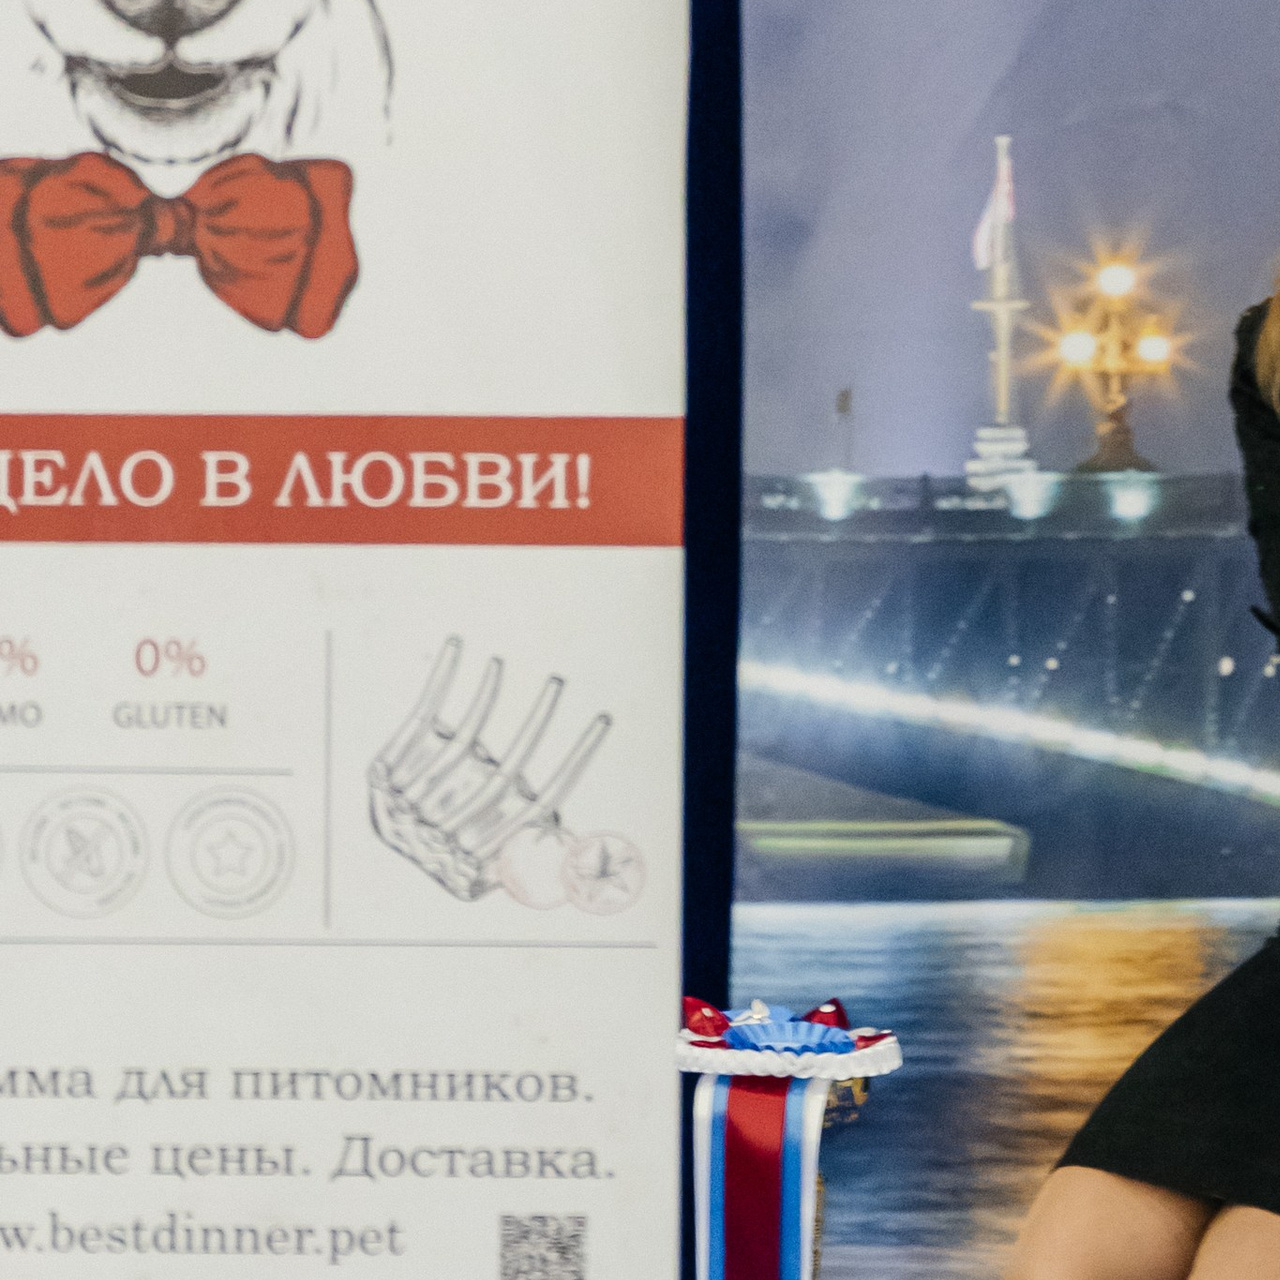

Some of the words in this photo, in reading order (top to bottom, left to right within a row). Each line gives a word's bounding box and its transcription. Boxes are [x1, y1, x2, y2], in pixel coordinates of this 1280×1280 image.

[201, 451, 252, 506] В
[276, 451, 590, 508] ЛЮБВИ!
[135, 638, 205, 677] 0%
[113, 702, 227, 729] GLUTEN
[115, 1069, 207, 1102] для
[233, 1070, 593, 1102] питомников.
[153, 1146, 310, 1178] цены.
[331, 1135, 614, 1180] Доставка.
